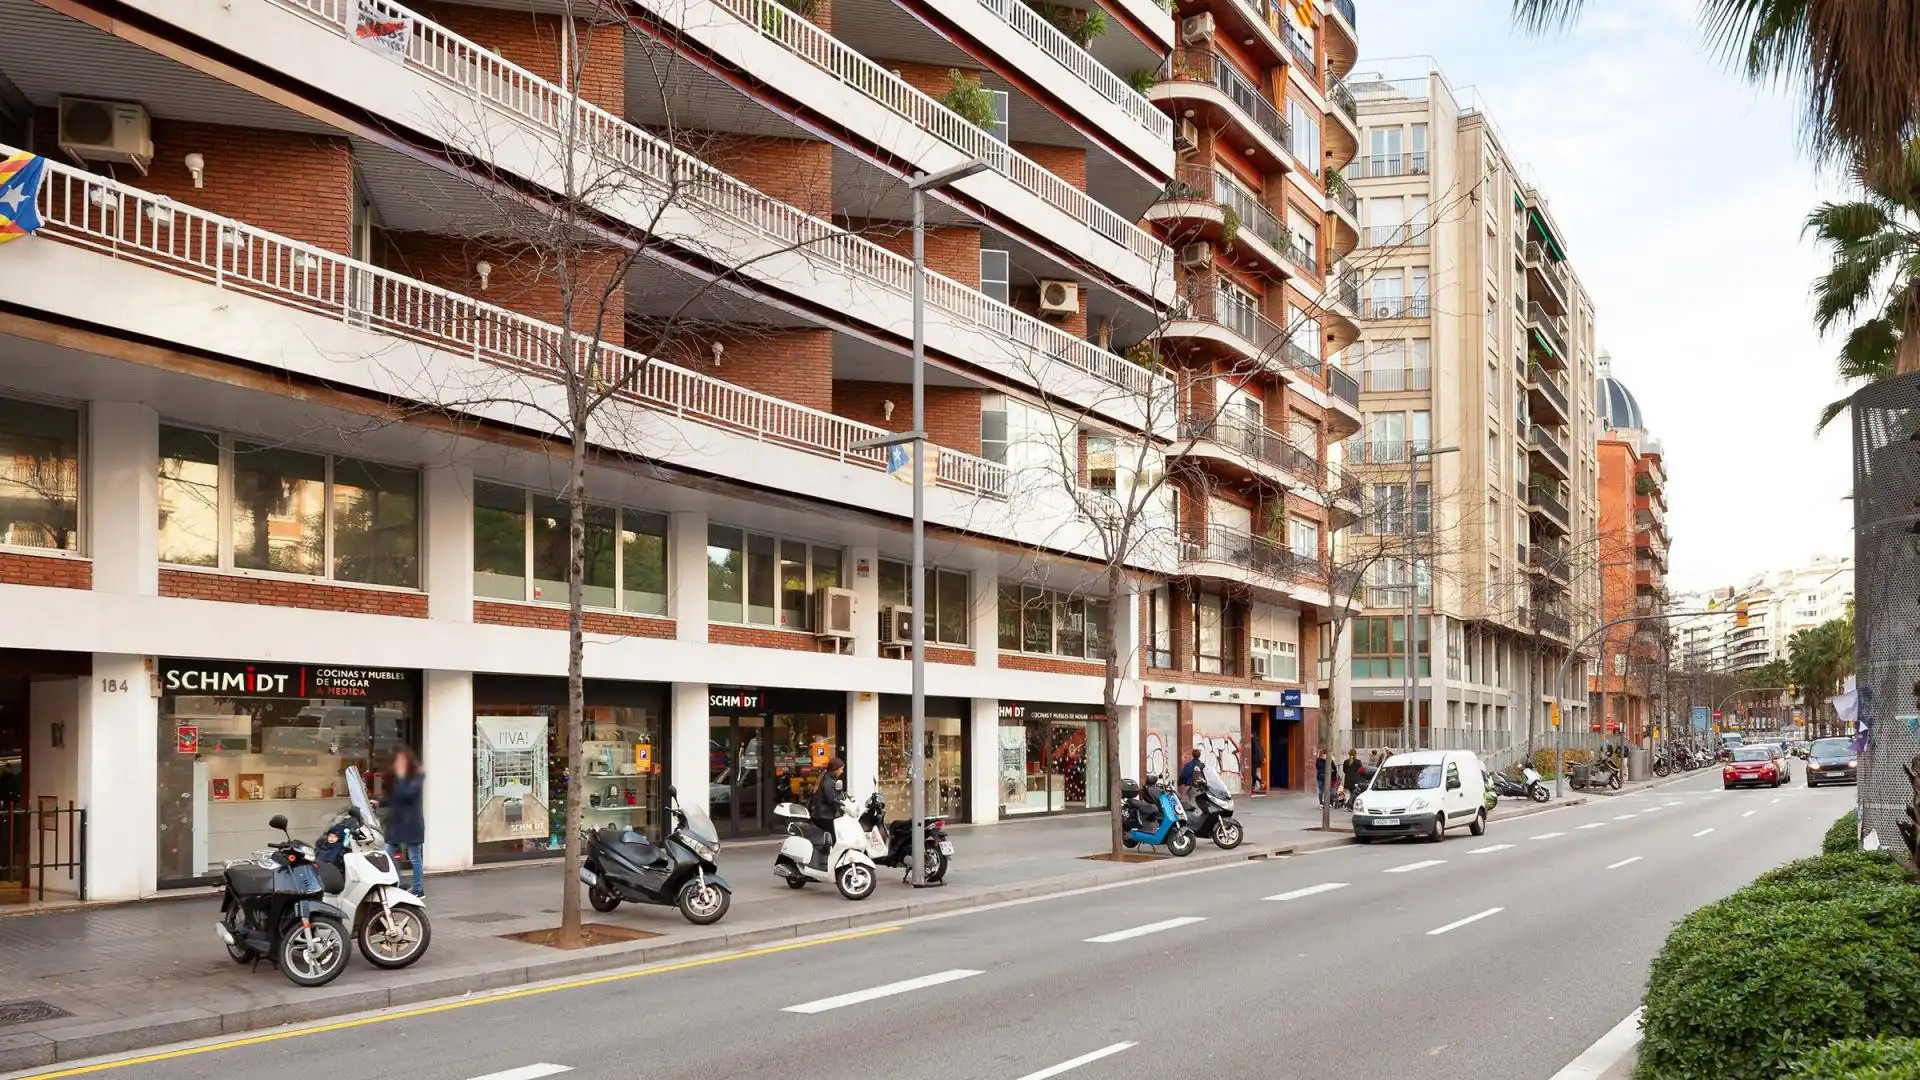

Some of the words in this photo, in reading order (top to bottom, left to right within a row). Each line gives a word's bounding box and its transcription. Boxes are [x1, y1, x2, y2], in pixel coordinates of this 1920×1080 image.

[316, 669, 359, 679] COCINAS
[360, 671, 367, 679] Y
[368, 671, 405, 680] MUEBLES
[102, 678, 129, 693] 184
[316, 678, 329, 686] DE
[333, 679, 370, 688] HOGAR
[327, 687, 367, 696] MEDIDA
